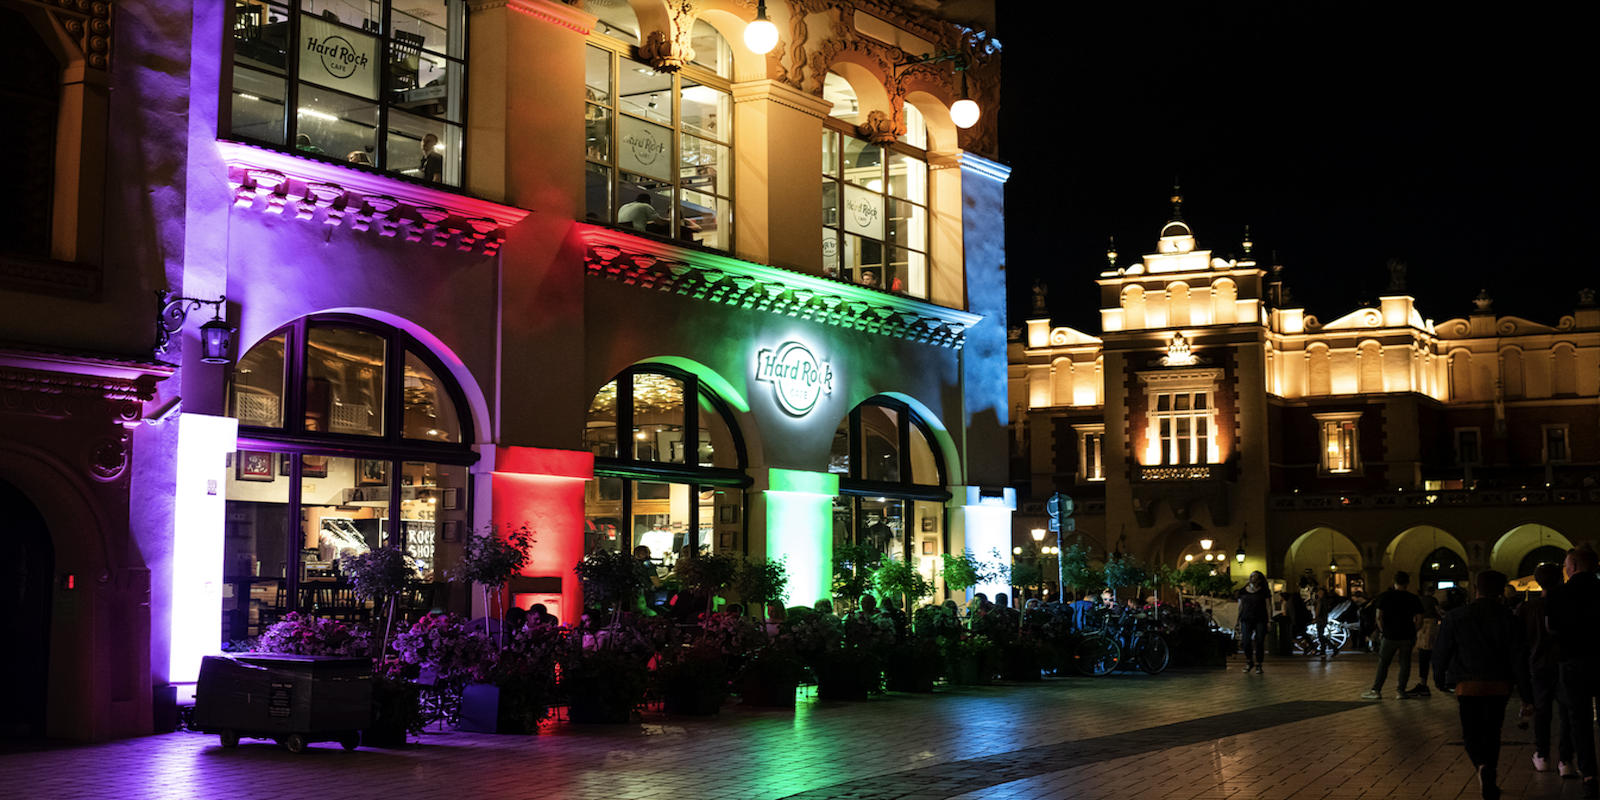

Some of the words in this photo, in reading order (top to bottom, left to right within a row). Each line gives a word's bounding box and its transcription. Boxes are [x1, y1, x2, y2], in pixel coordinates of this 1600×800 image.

[307, 37, 339, 58] Hard
[339, 46, 368, 70] Rock
[862, 204, 878, 220] Rock
[763, 354, 801, 380] Hard
[801, 360, 833, 390] Rock
[790, 388, 808, 400] CAFE
[408, 529, 435, 544] ROCK
